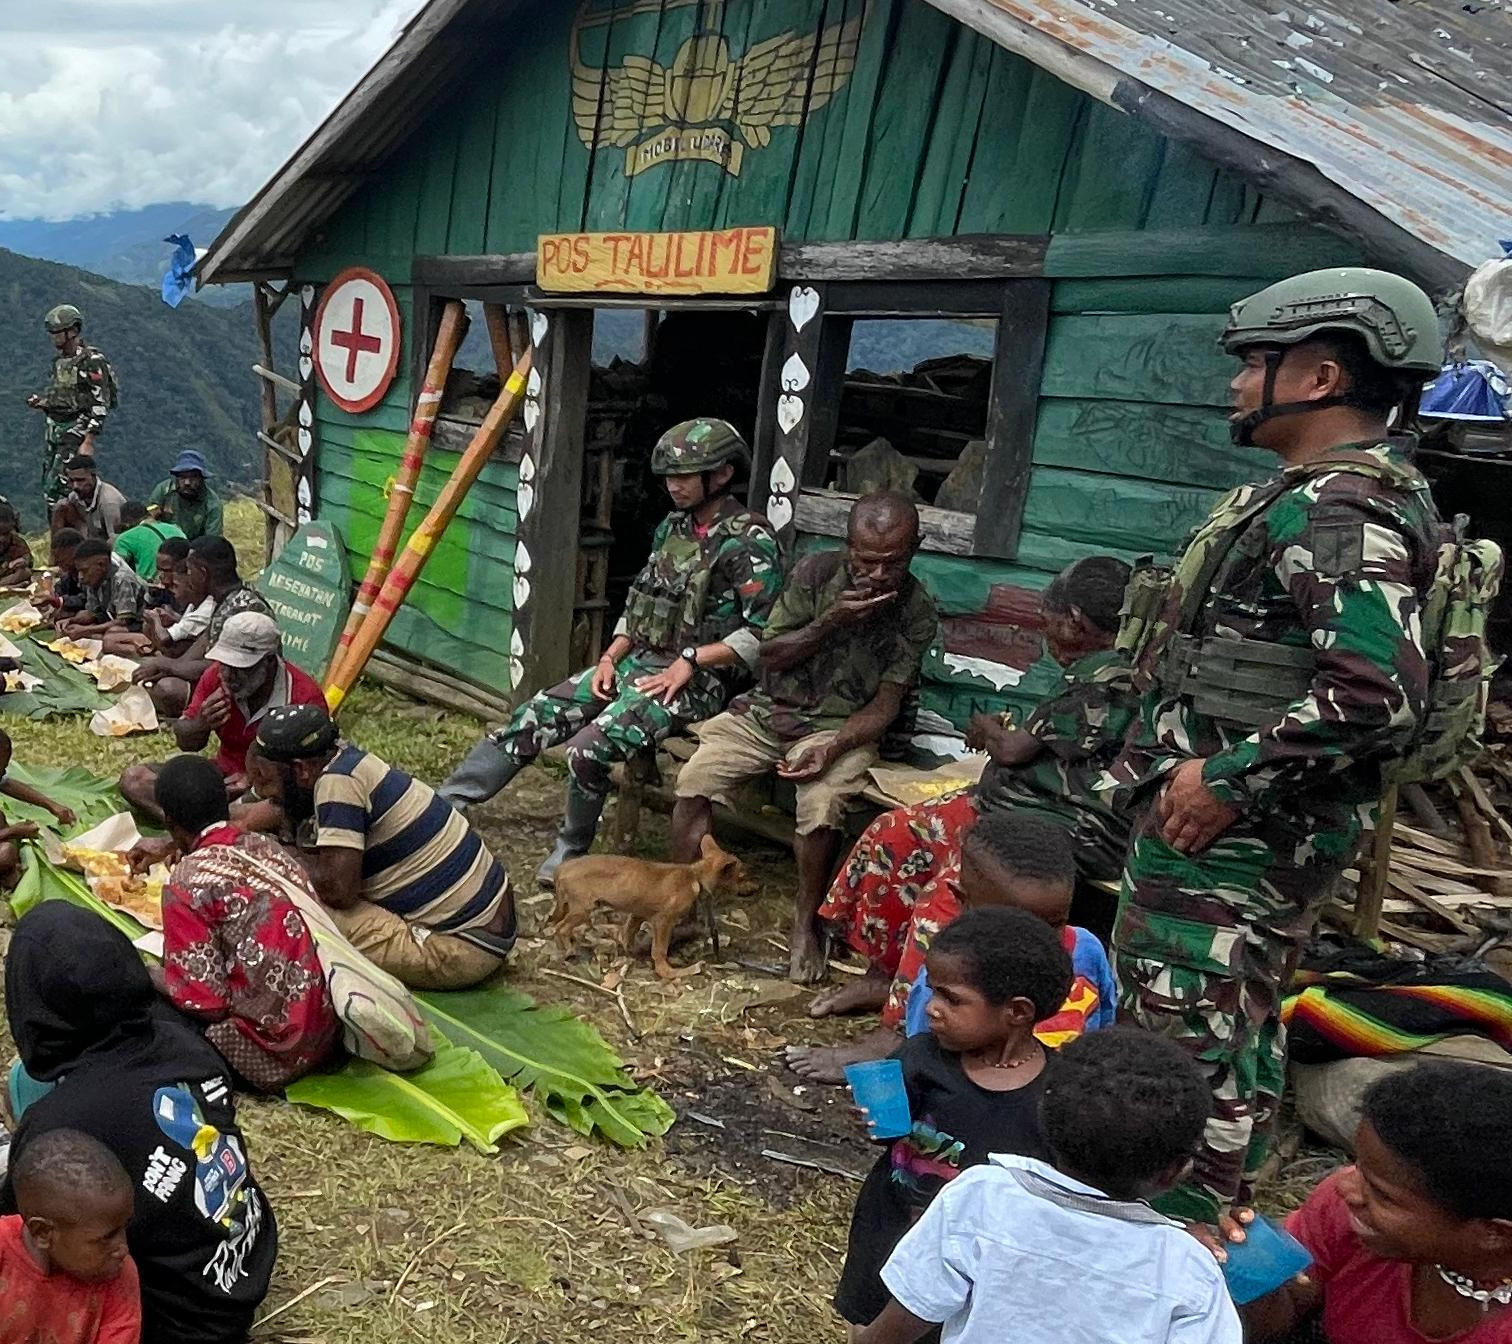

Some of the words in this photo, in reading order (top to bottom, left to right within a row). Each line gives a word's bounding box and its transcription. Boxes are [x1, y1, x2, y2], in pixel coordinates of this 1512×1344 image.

[542, 236, 590, 276] POS
[299, 551, 325, 570] POS
[154, 1157, 187, 1203] PANIC
